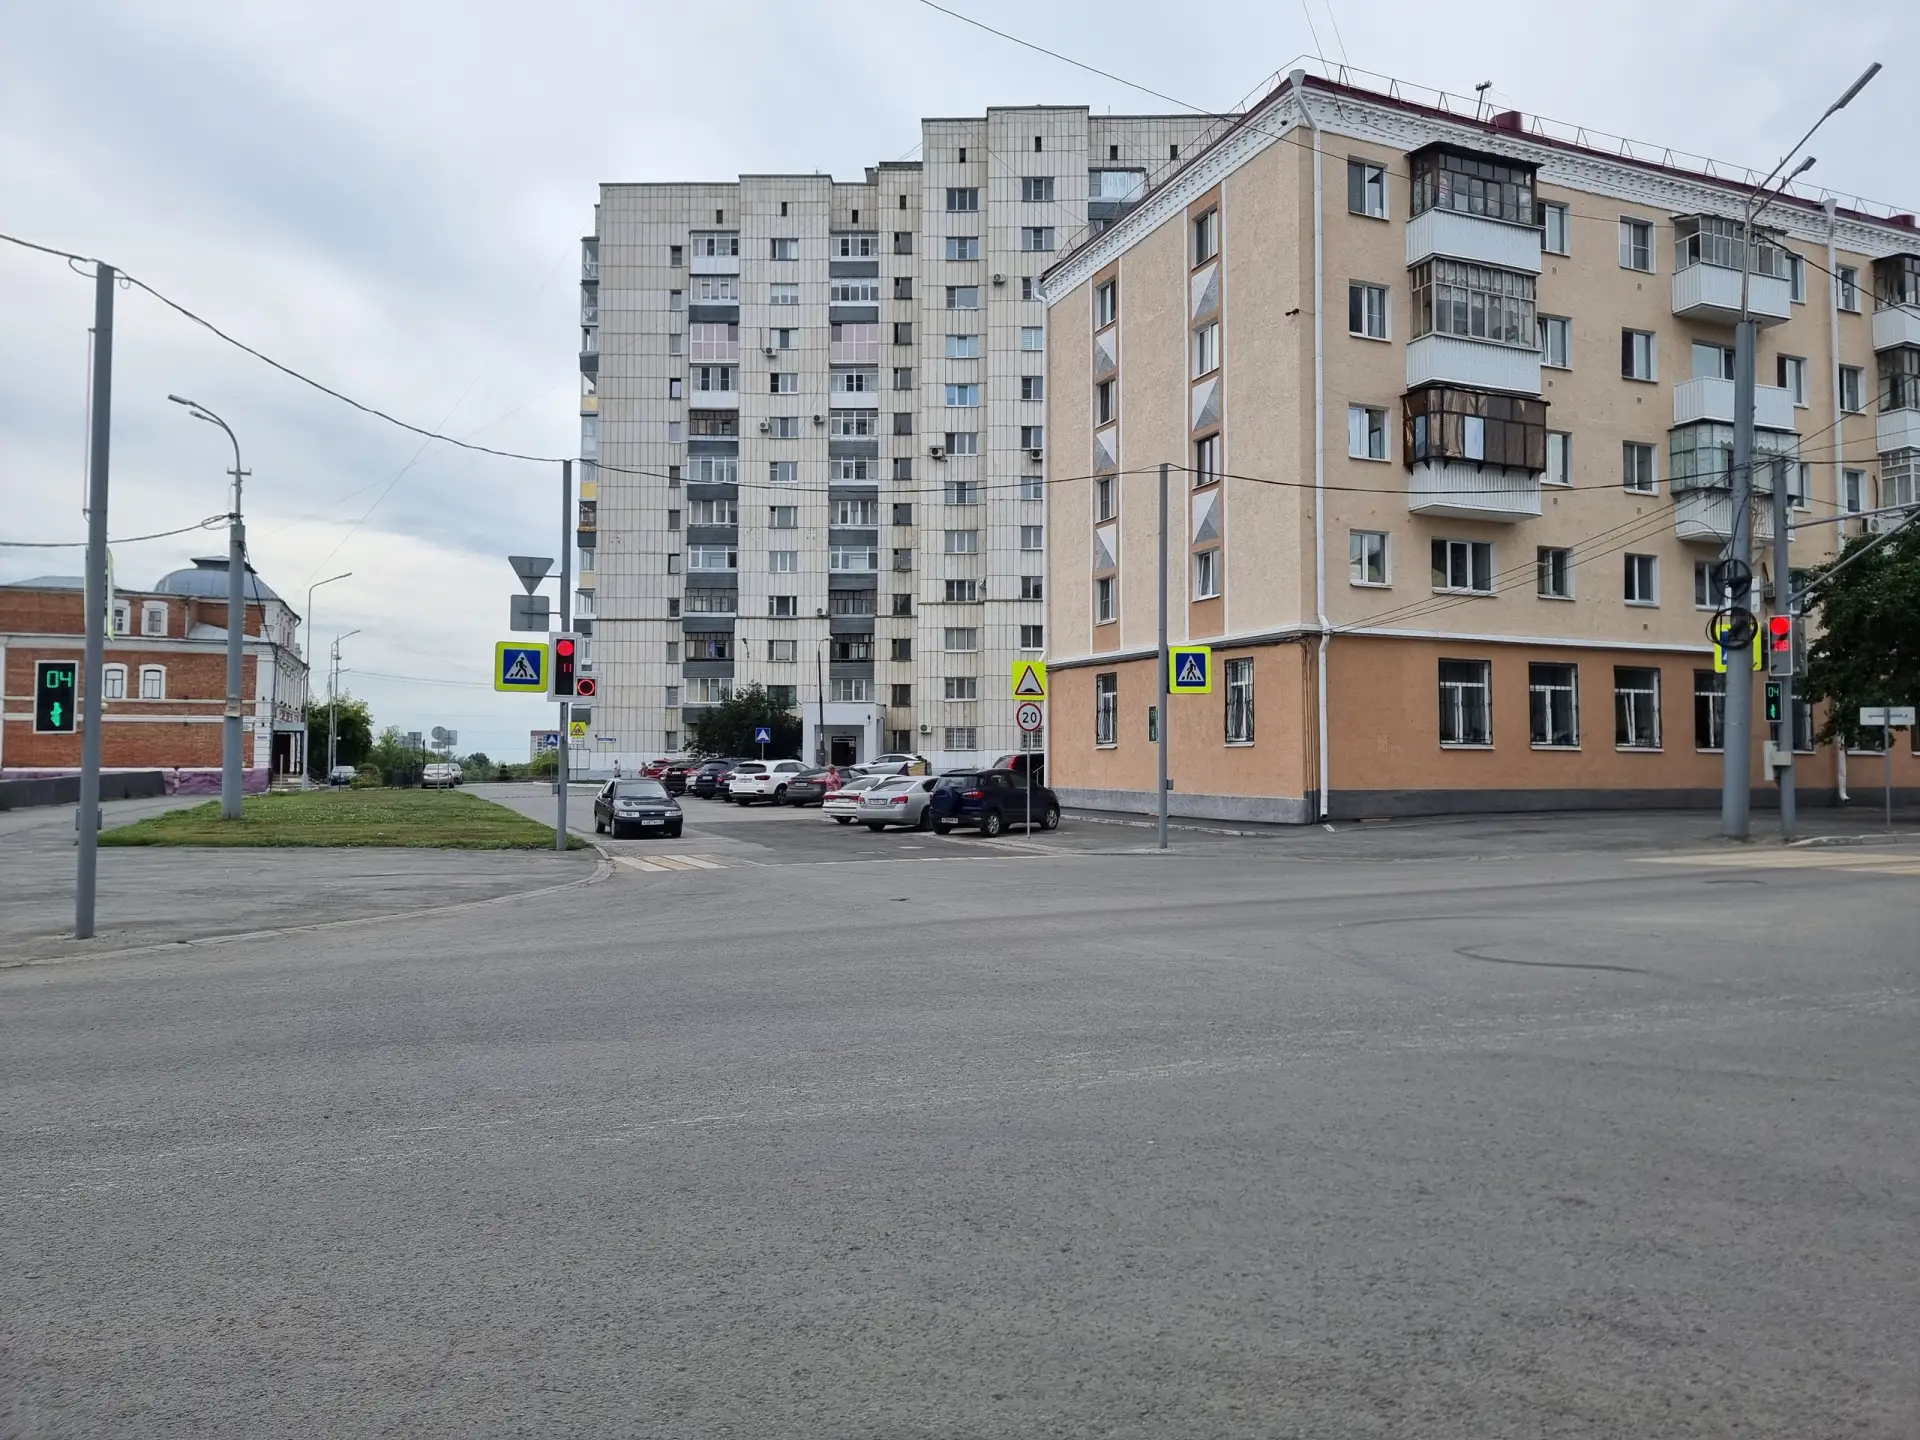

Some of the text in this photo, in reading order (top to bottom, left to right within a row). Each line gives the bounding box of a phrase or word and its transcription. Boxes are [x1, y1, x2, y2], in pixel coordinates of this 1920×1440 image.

[563, 663, 572, 673] 11
[46, 670, 72, 688] 04
[1768, 687, 1779, 697] 04
[1022, 712, 1037, 724] 20
